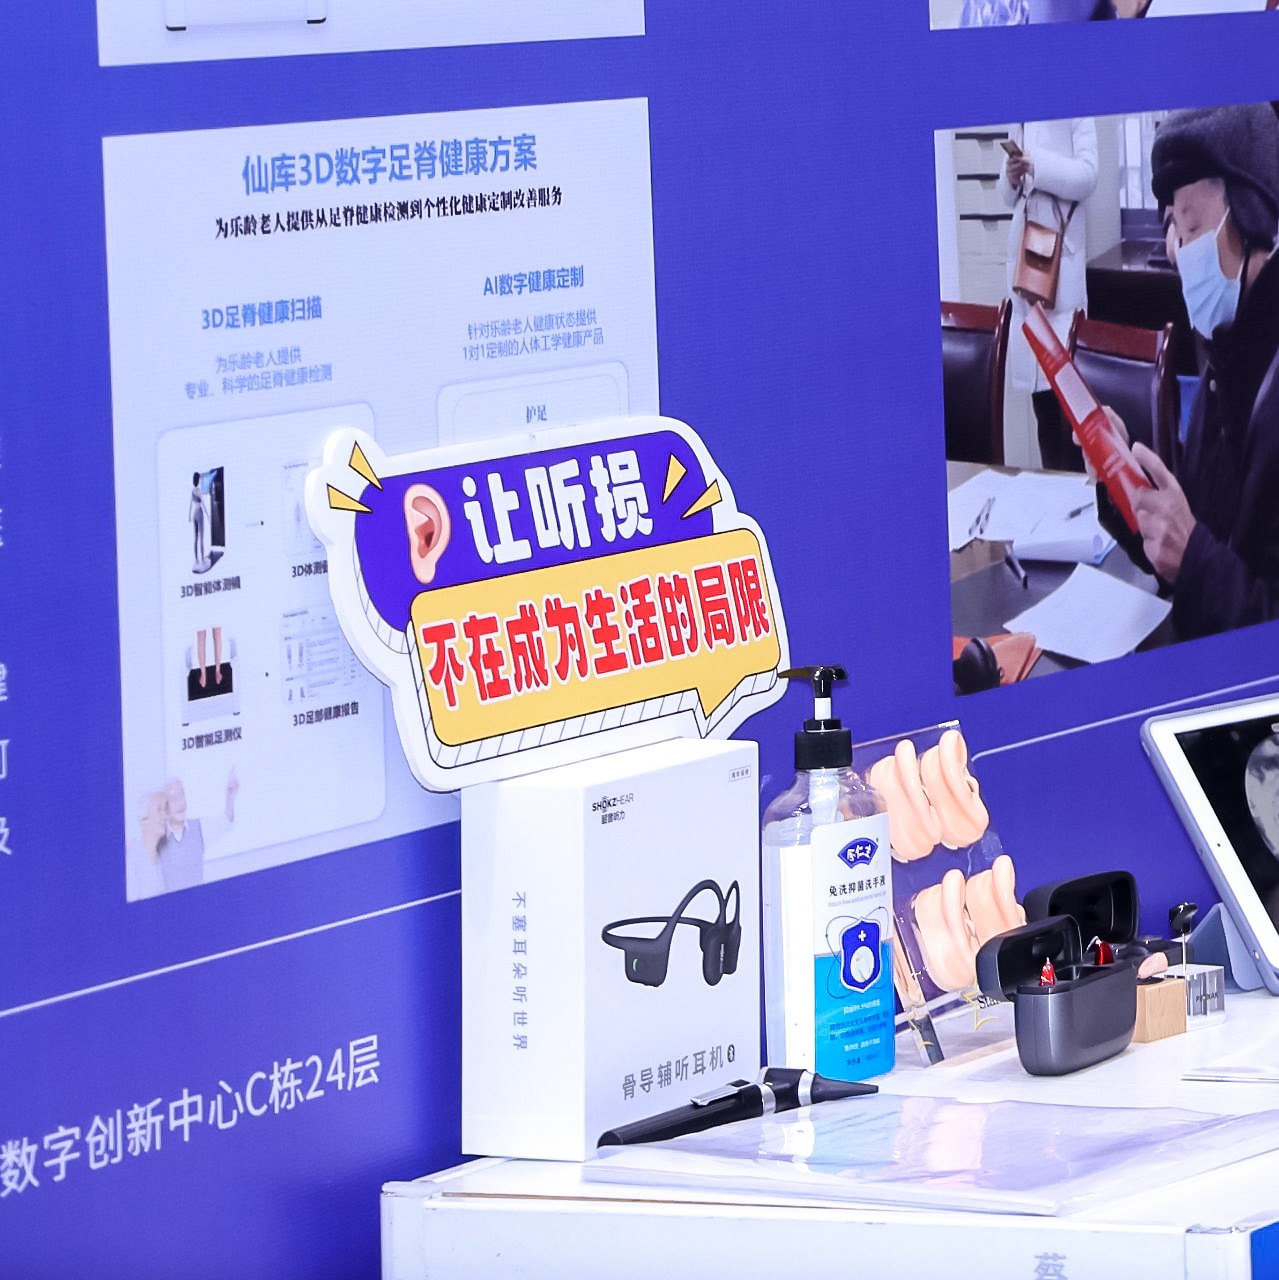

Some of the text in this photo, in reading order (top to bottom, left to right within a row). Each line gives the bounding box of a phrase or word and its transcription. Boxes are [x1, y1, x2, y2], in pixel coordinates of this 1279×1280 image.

[242, 133, 538, 196] 仙库3D数字足脊健康方案
[483, 265, 584, 297] AI数字健康定制
[201, 296, 322, 330] 3D足脊健康扫描
[461, 450, 653, 564] 让听损
[423, 558, 769, 708] 不在成为生活的局限
[829, 875, 885, 897] 免洗抑菌洗手液
[511, 892, 528, 1050] 不塞耳朵听世界
[622, 1045, 724, 1100] 骨导辅听耳机
[0, 1034, 380, 1198] 数字创新中心C栋24层
